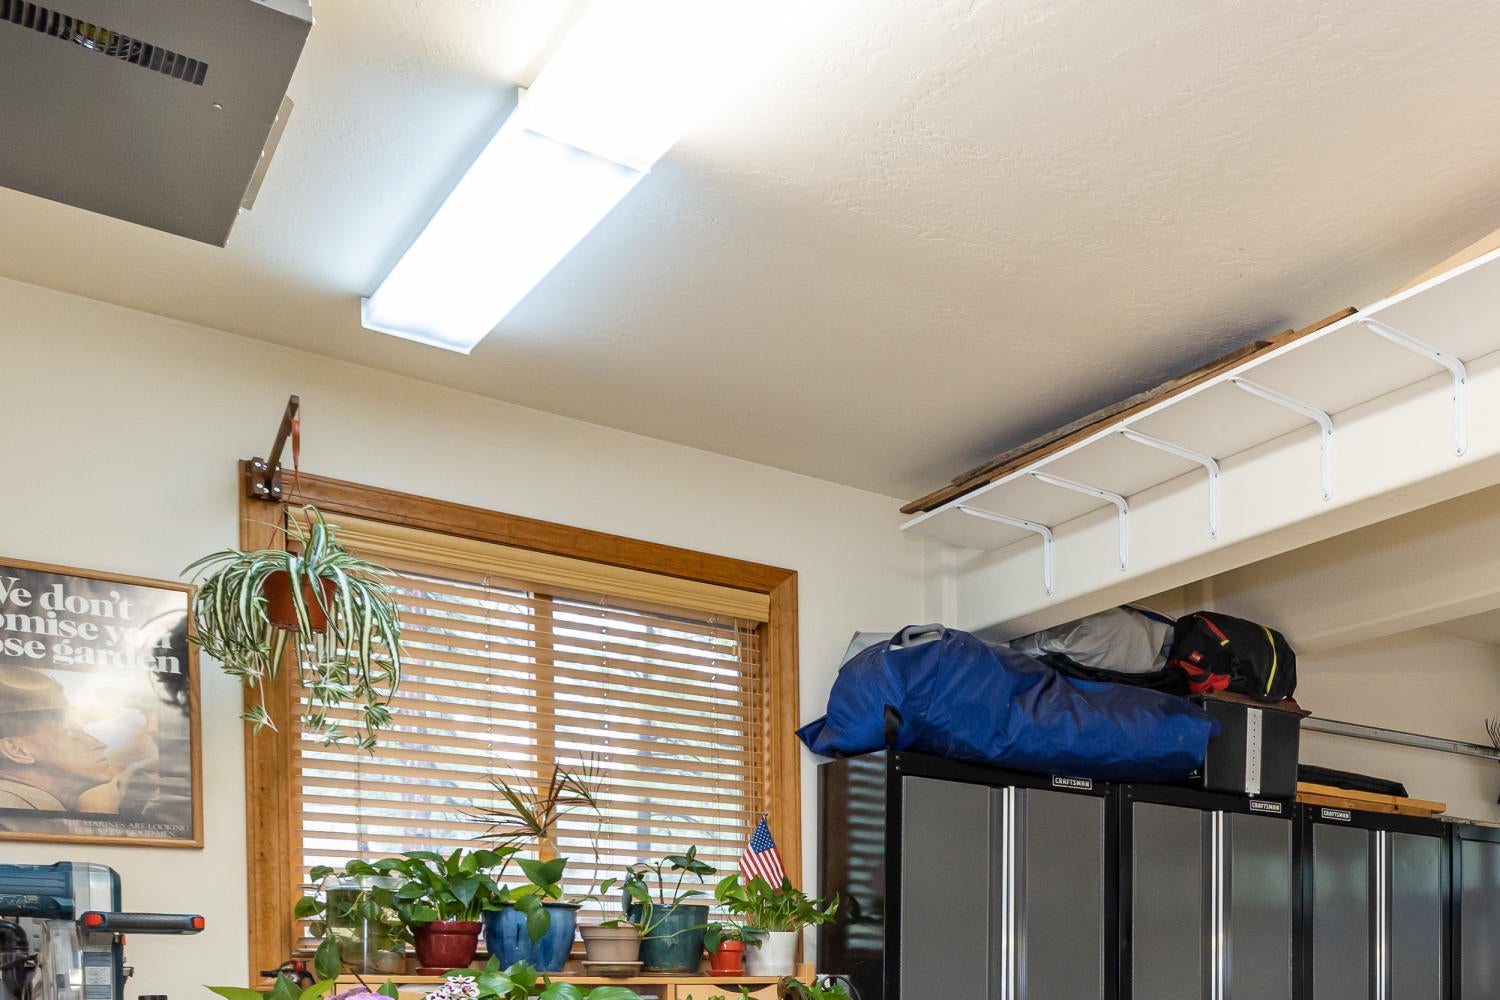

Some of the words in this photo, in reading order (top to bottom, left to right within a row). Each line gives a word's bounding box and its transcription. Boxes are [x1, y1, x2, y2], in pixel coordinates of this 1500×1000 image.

[39, 583, 133, 620] don't
[0, 611, 99, 641] mise
[0, 637, 46, 659] se
[52, 638, 182, 675] garden
[1054, 777, 1090, 788] CRAFTSMAN
[1251, 802, 1280, 811] CRAFTSMAN
[1323, 810, 1350, 819] CRAFTSMAN
